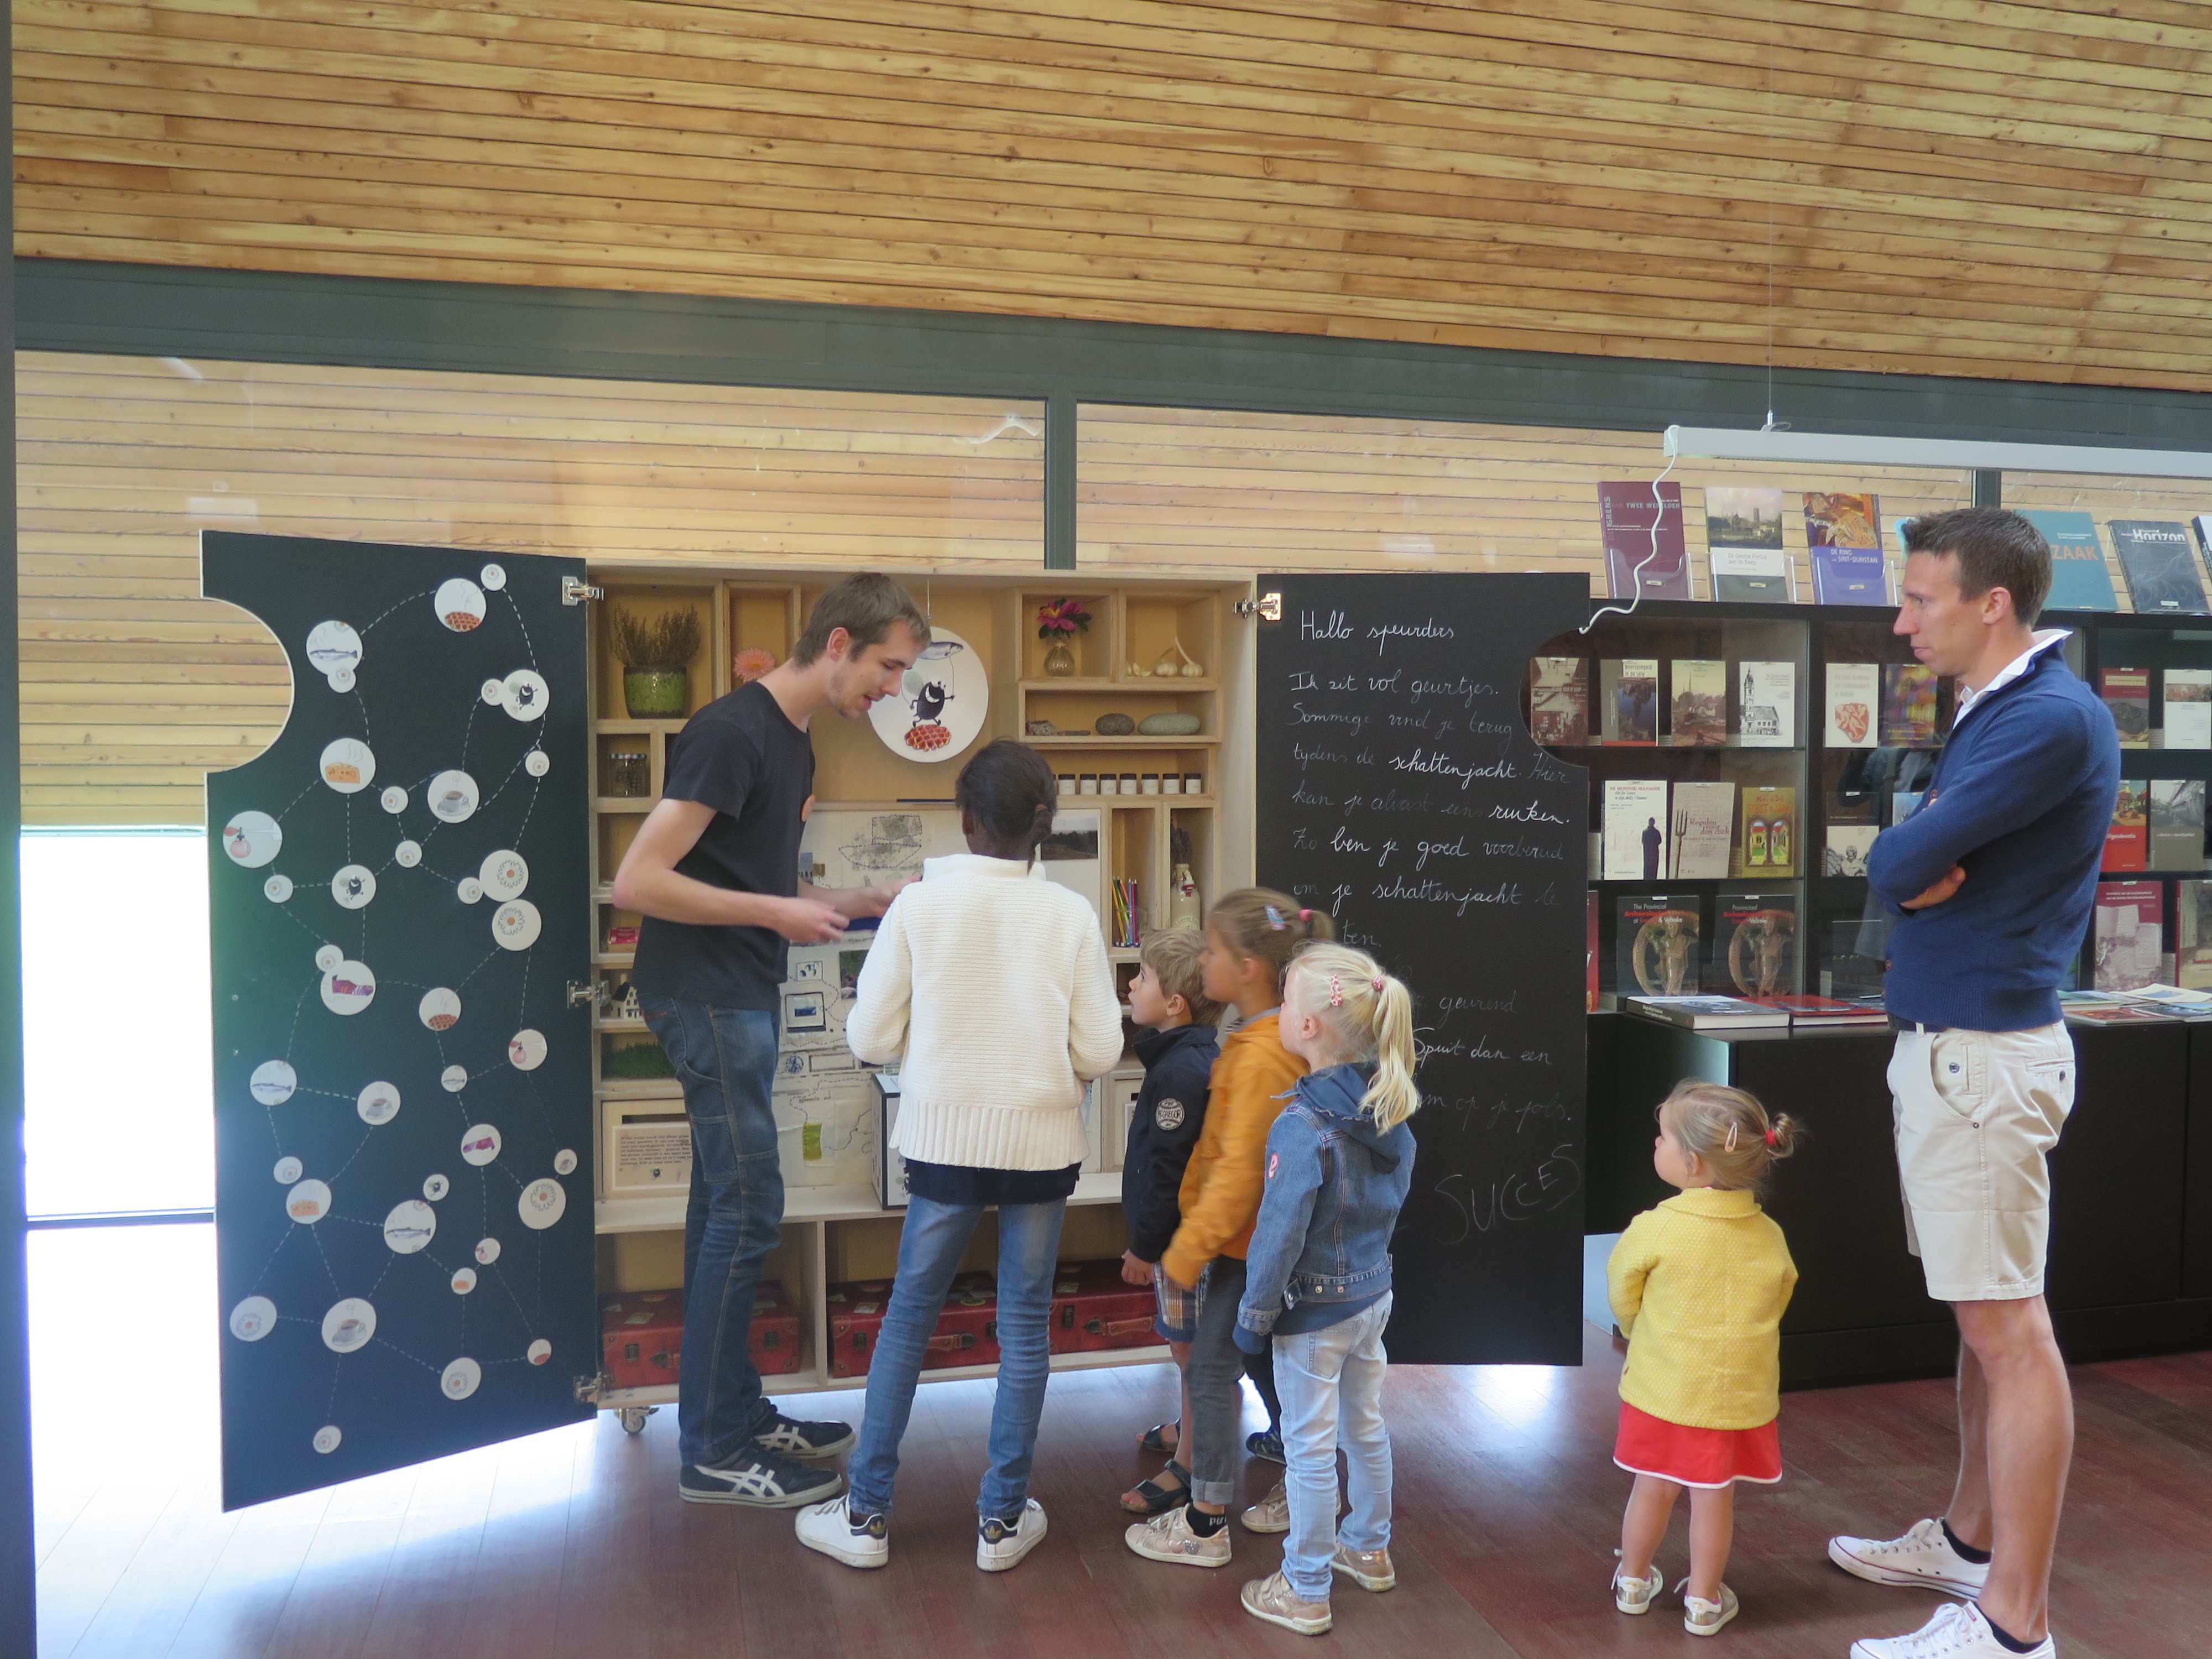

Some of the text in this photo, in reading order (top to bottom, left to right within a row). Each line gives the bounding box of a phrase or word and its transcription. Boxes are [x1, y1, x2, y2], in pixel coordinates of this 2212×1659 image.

[2132, 528, 2186, 541] Horizon
[1301, 609, 1455, 657] Hallo speurders
[1287, 671, 1319, 692] Ik
[1328, 676, 1358, 692] zit
[1368, 669, 1402, 693] vol
[1288, 702, 1370, 737] Sommige
[1388, 708, 1430, 730] vind
[1469, 711, 1513, 757] terug
[1291, 779, 1335, 807] kan
[1329, 826, 1371, 853] ben
[1378, 837, 1400, 868] je
[1416, 836, 1470, 872] goed
[1332, 883, 1353, 918] je
[1371, 875, 1522, 917] schattenjacht
[1470, 1035, 1510, 1061] dan
[1520, 1050, 1554, 1066] een
[1434, 1144, 1581, 1244] SUCCES
